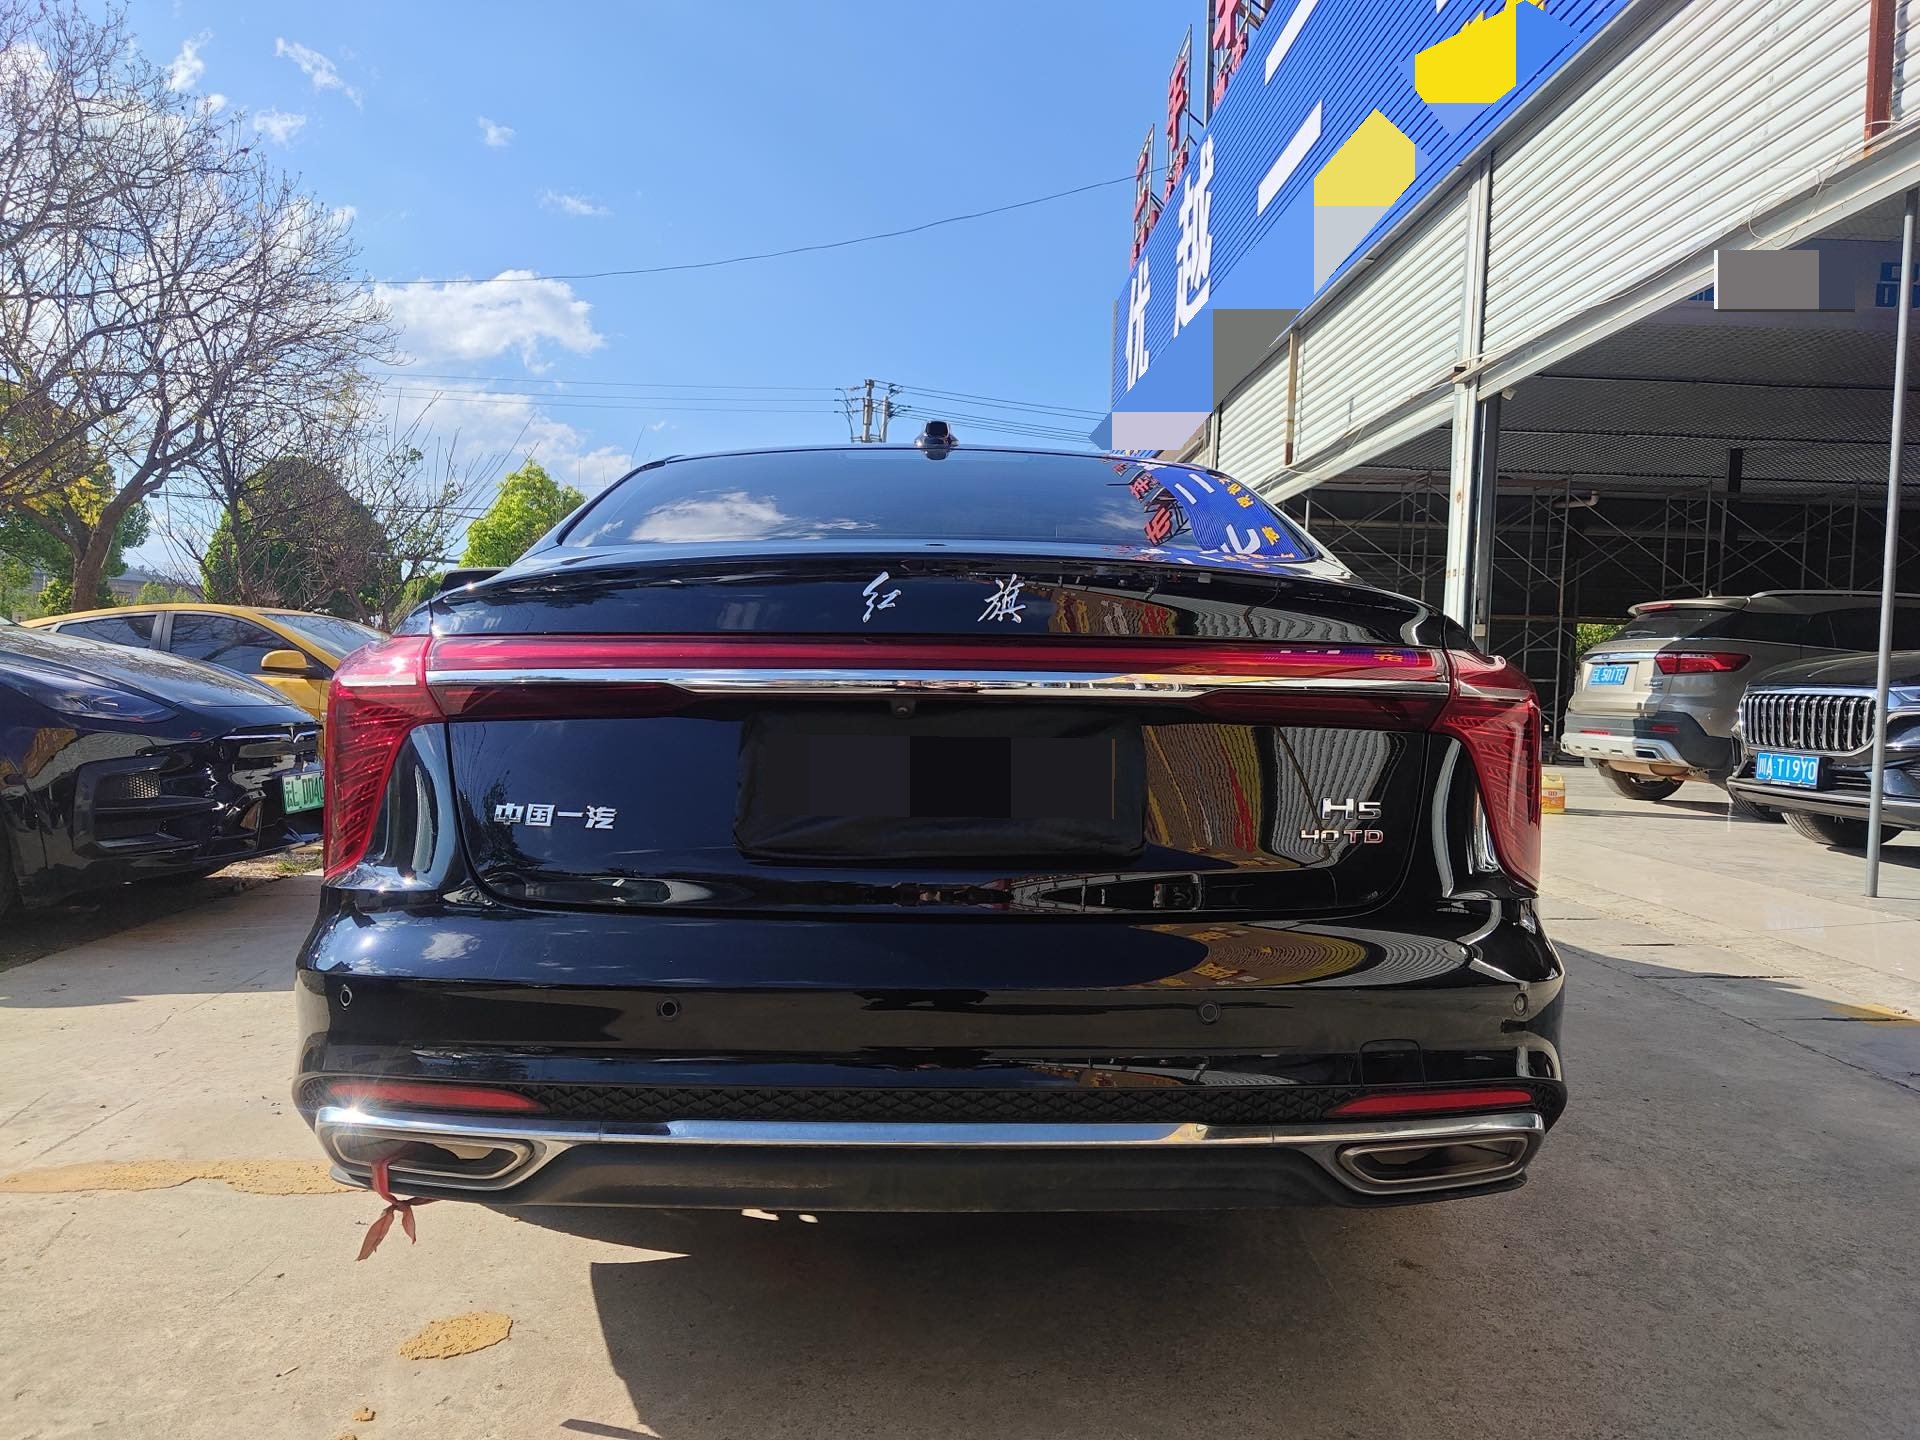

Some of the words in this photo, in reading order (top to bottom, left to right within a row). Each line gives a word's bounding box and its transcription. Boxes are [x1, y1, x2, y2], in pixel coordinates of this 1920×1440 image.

[862, 571, 1027, 624] 红旗
[493, 802, 618, 829] 中国一汽
[1321, 797, 1382, 820] H5
[1300, 829, 1384, 844] 40TD
